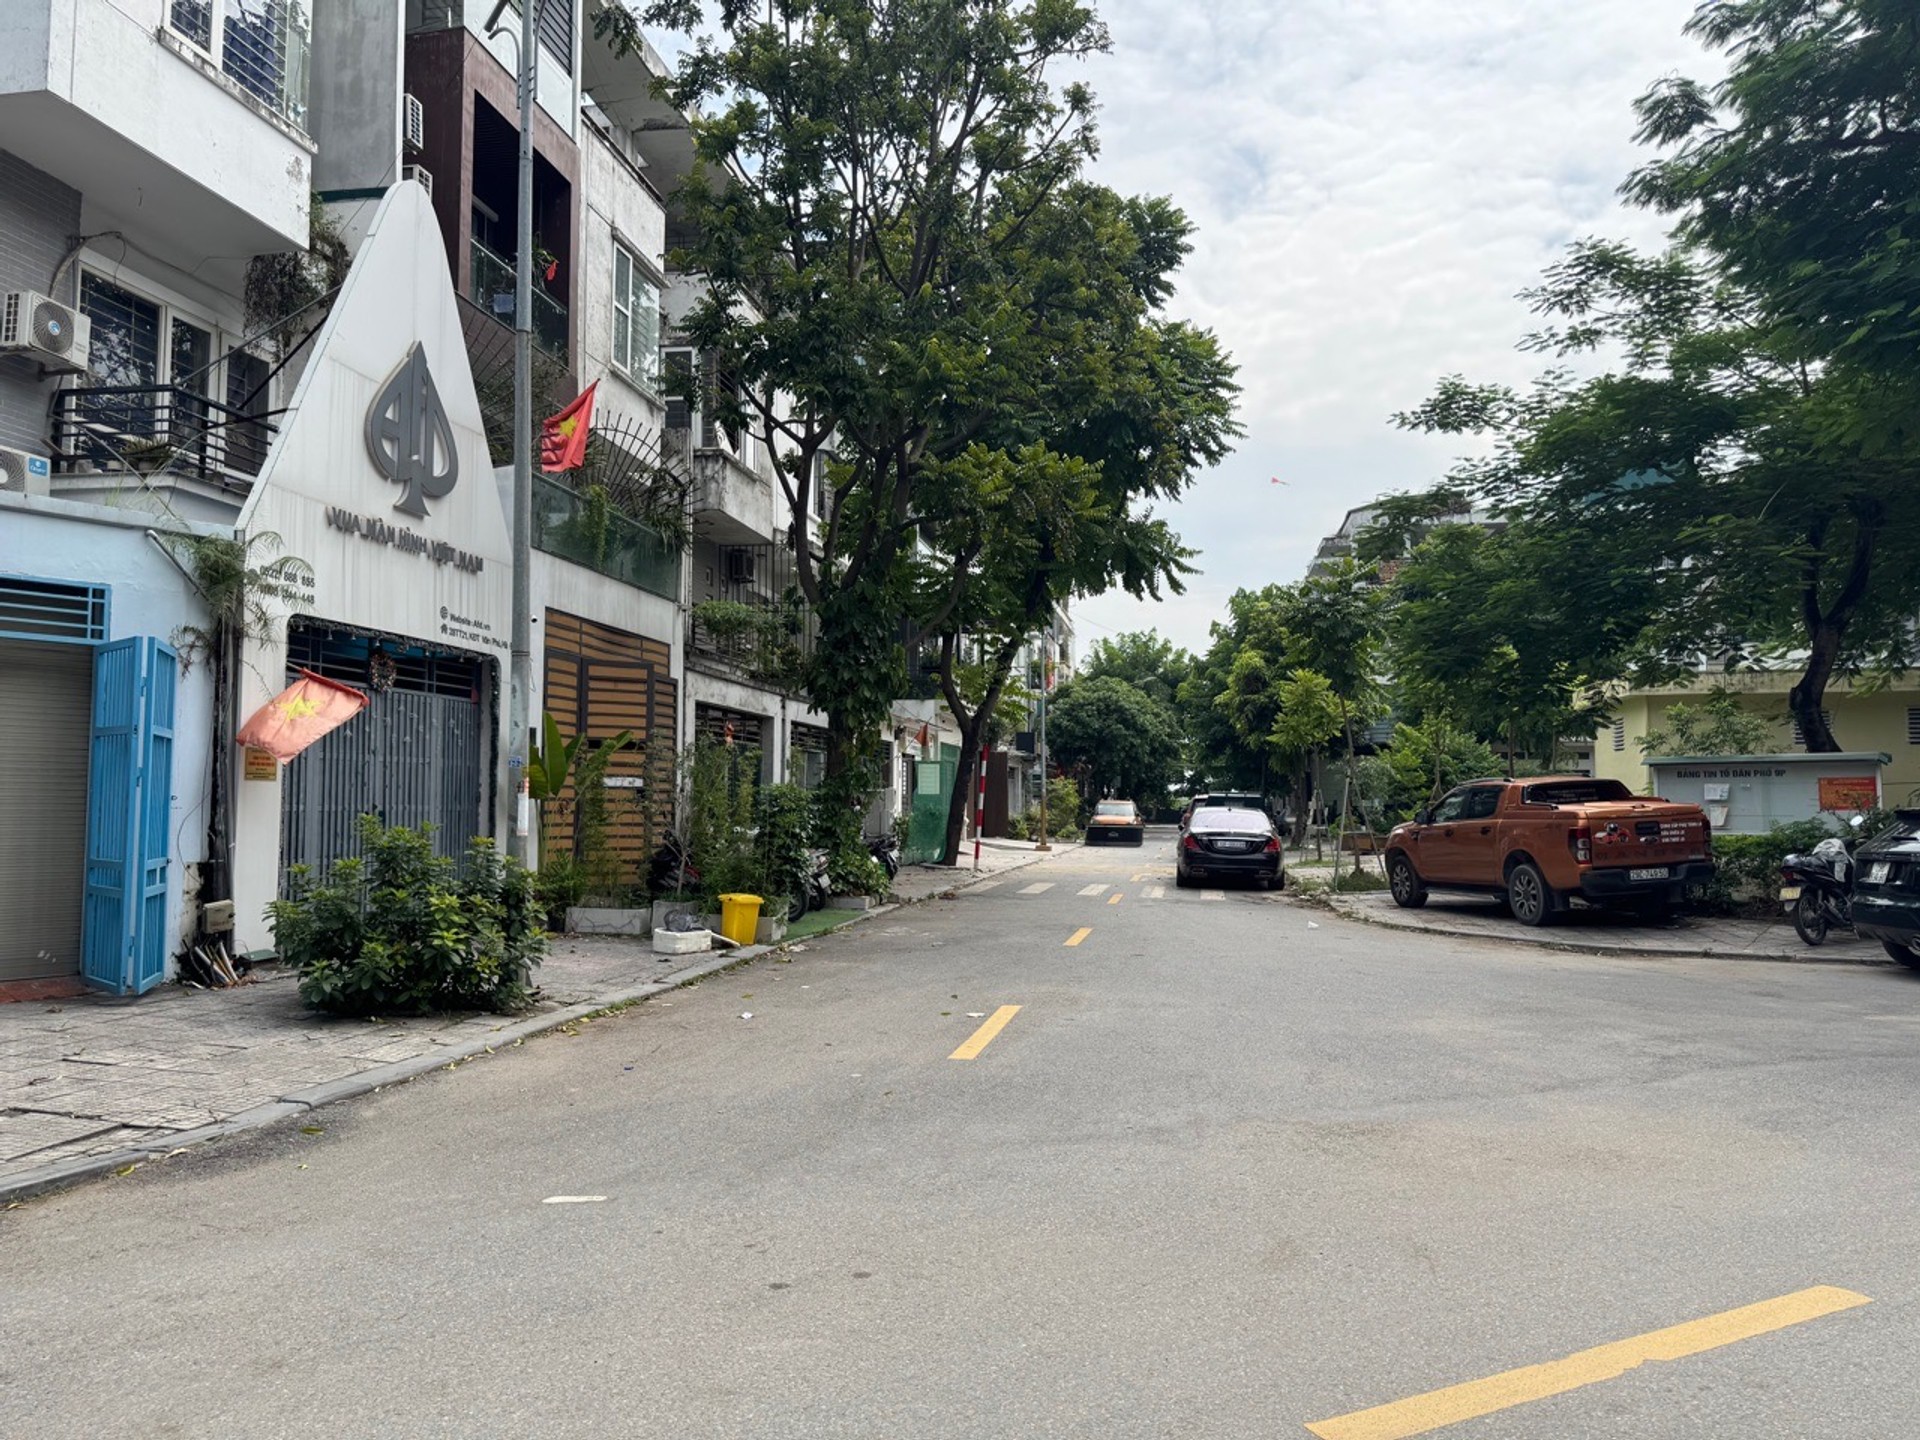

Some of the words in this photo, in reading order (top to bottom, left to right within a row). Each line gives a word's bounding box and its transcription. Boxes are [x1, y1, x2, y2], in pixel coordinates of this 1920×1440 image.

[327, 506, 362, 534] VUA
[458, 550, 483, 573] NAM
[1677, 767, 1700, 779] BẢNG
[1703, 769, 1717, 779] TIN
[1732, 768, 1751, 778] DÂN
